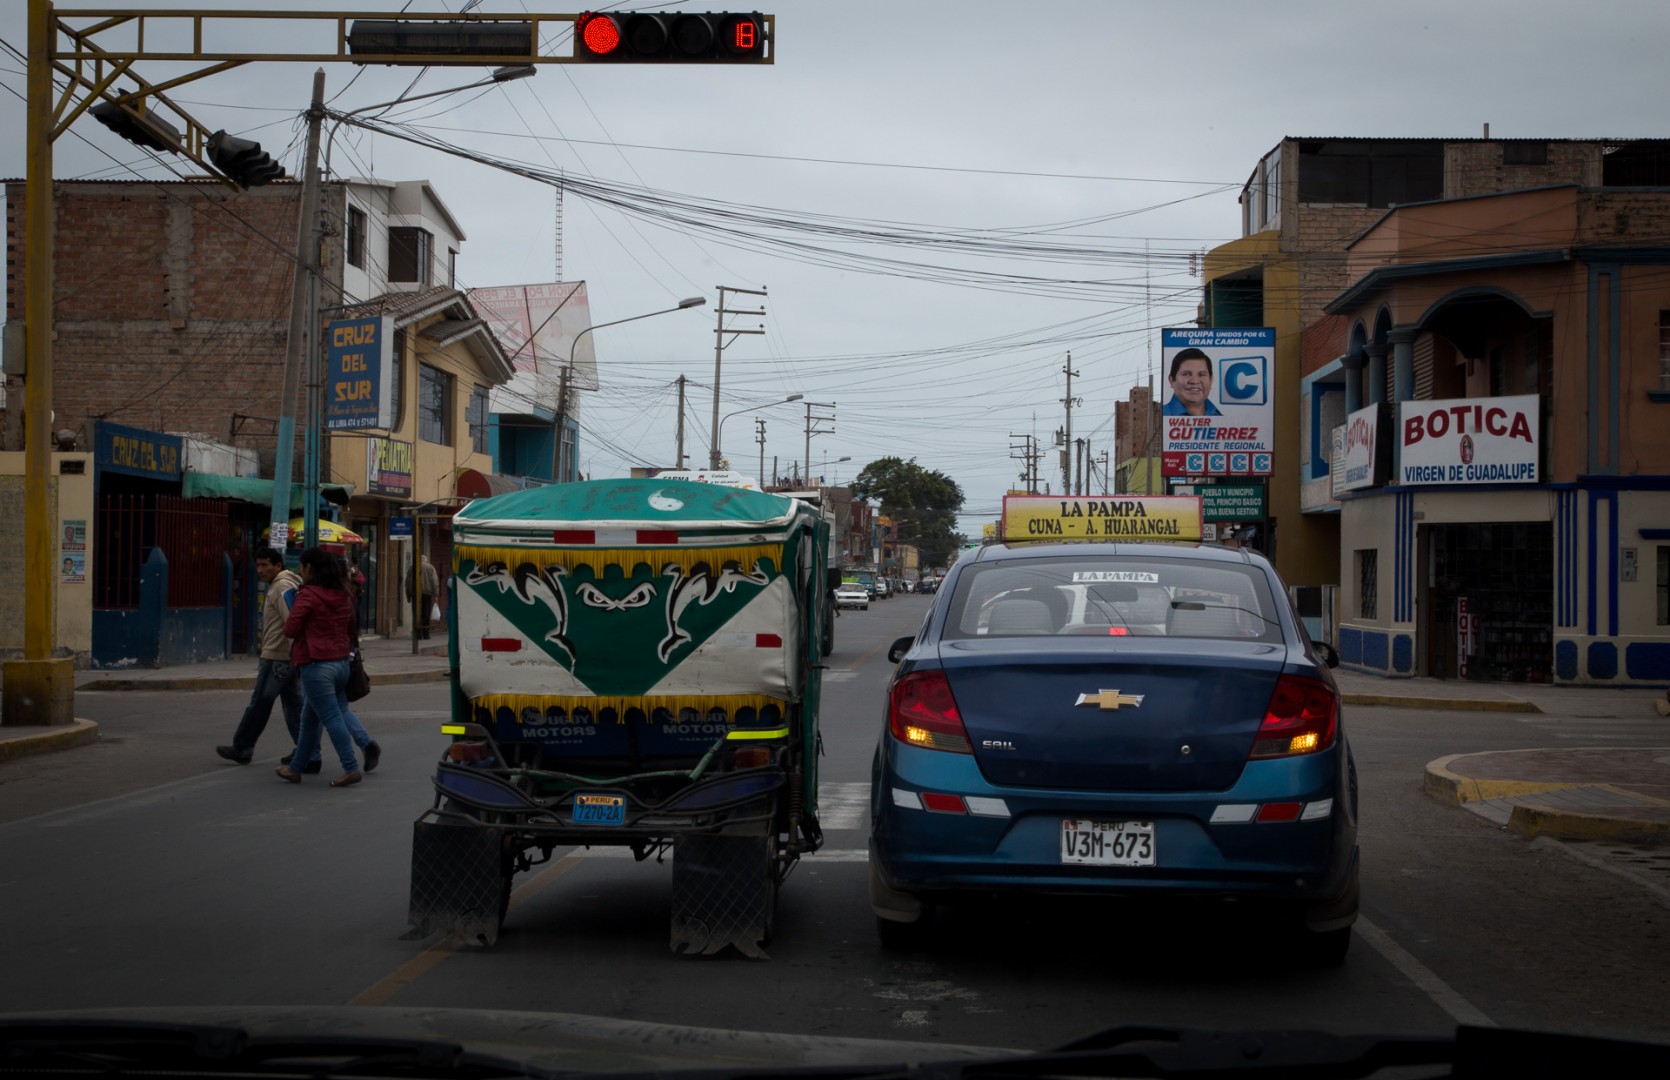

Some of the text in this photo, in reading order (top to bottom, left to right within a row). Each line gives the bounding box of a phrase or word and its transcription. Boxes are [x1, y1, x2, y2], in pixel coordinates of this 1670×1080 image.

[736, 22, 754, 48] 18
[333, 323, 375, 348] CRUZ
[1170, 330, 1214, 341] AREQUIPA
[1188, 338, 1249, 346] GRAN CAMBIO
[342, 353, 367, 373] DEL
[1225, 362, 1258, 399] C
[335, 380, 372, 402] SUR
[1169, 418, 1211, 427] WALTER
[1405, 405, 1534, 446] BOTICA
[1169, 427, 1258, 440] GUTIERREZ
[1168, 442, 1266, 450] PRESIDENTE REGIONAL
[113, 435, 177, 474] CRUZ DEL SUR
[377, 438, 412, 474] PEDIATRIA
[1404, 463, 1535, 482] VIRGEN DE GUADALUPE
[1202, 488, 1254, 496] PUEBLO Y MUNICIPIO
[1061, 501, 1146, 517] LA PAMPA
[1216, 498, 1241, 506] PRINCIPIO
[1206, 508, 1217, 516] UNA
[1218, 508, 1236, 516] BUENA
[1029, 518, 1063, 535] CUNA
[1085, 518, 1098, 535] A.
[1104, 518, 1180, 535] HUARANGAL
[1077, 572, 1154, 581] LA PAMPA
[522, 726, 598, 738] MOTORS
[982, 739, 1017, 751] SAIL
[579, 805, 620, 820] 7270-2A
[1092, 822, 1124, 832] PERU
[1065, 831, 1151, 859] V3M-673
